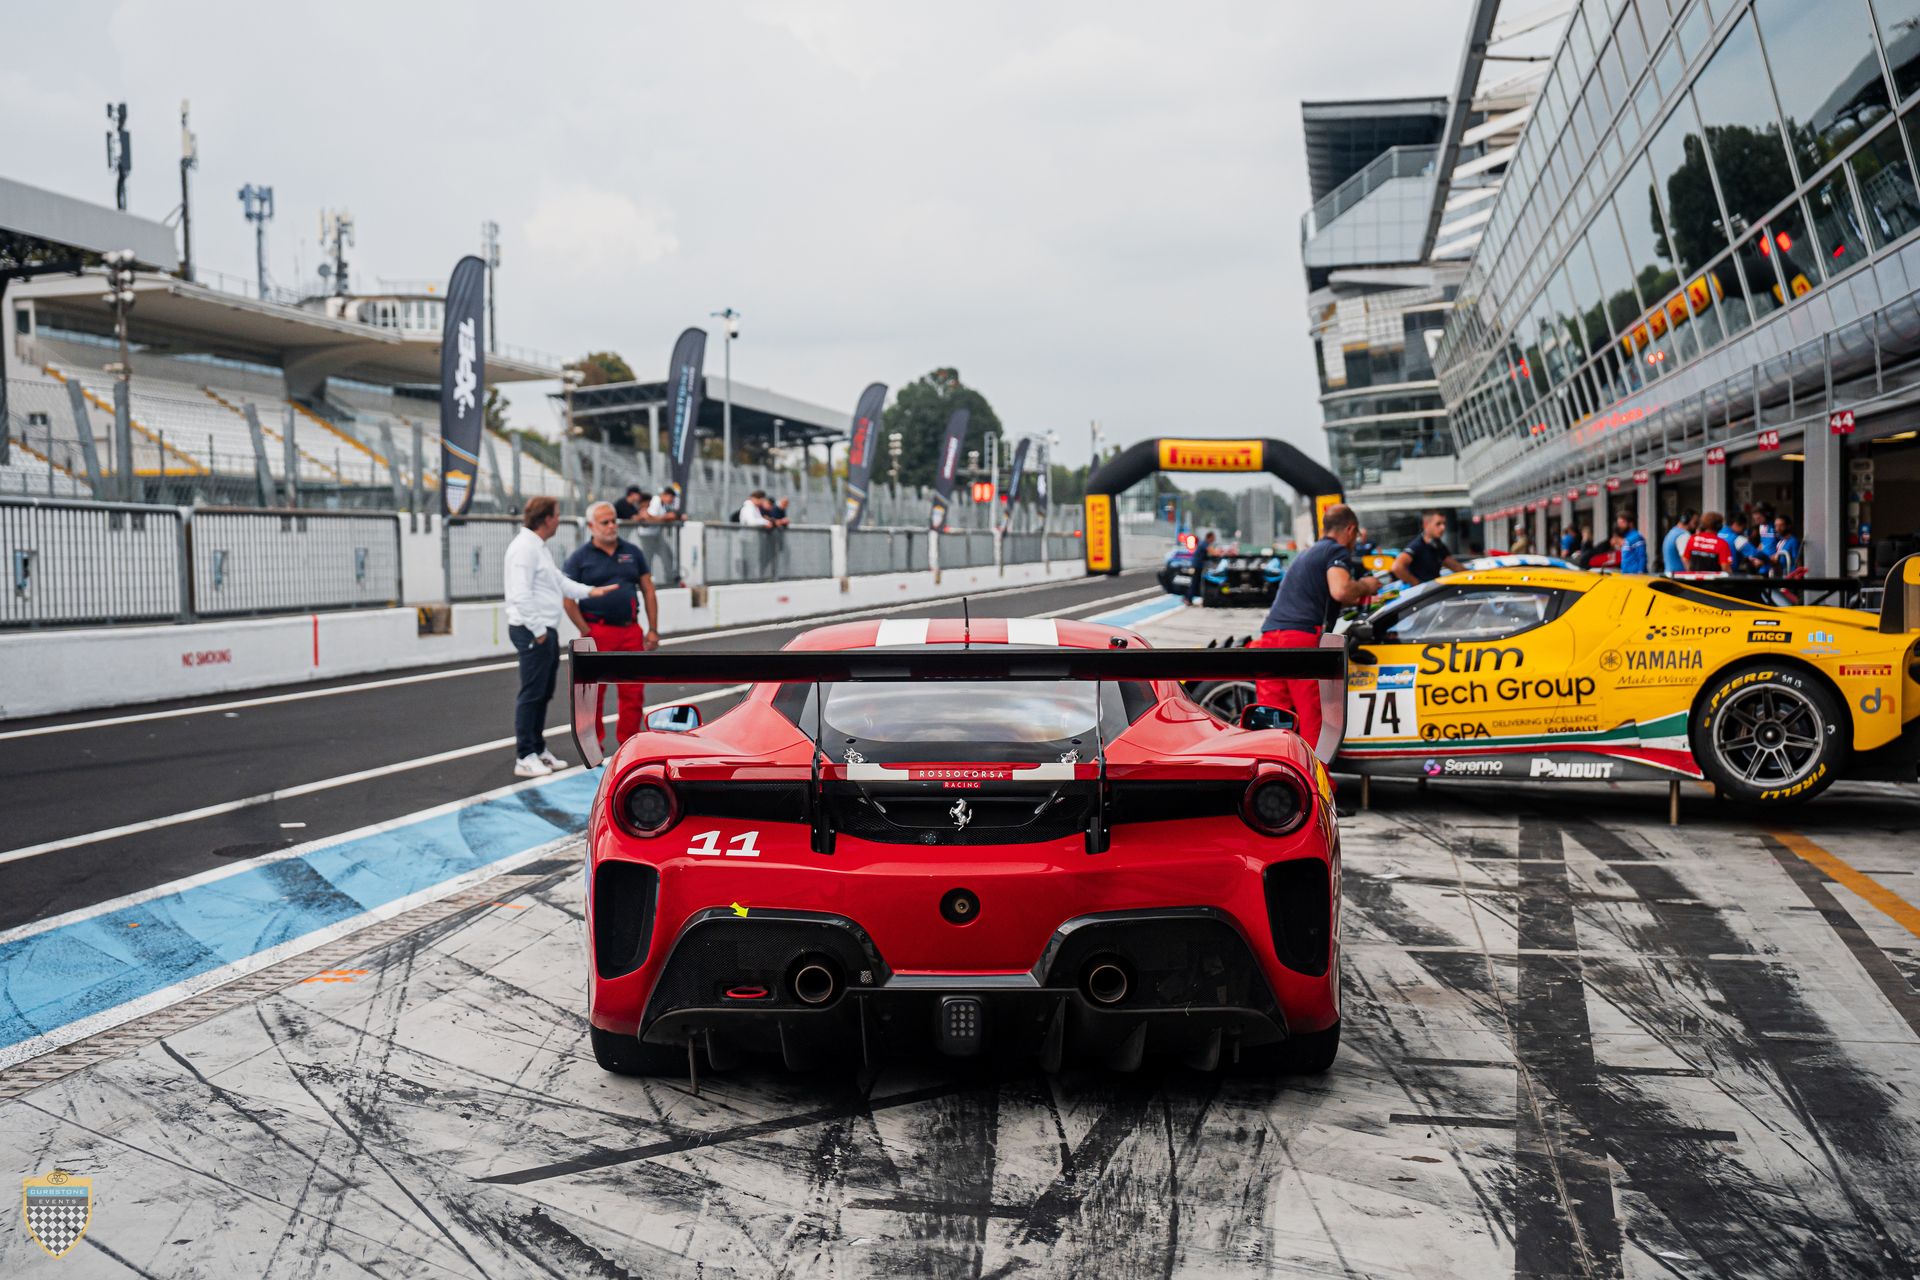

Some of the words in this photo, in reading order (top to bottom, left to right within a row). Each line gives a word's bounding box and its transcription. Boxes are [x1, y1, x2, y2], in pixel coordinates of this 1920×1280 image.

[1831, 413, 1854, 427] 44
[1758, 432, 1779, 445] 45
[1170, 447, 1251, 466] PIRELLI
[1671, 625, 1731, 638] Sintpro
[1752, 632, 1786, 641] mca
[1419, 643, 1524, 675] Stim
[1625, 649, 1703, 670] YAMAHA
[1839, 664, 1892, 676] PIRELLI
[1416, 681, 1488, 706] Tech
[1496, 675, 1596, 704] Group
[1359, 692, 1400, 736] 74
[1492, 718, 1541, 728] DELIVERING
[1544, 714, 1598, 725] EXCELLENCE
[1443, 723, 1492, 740] GPA
[1547, 725, 1599, 734] GLOBALLY
[1445, 759, 1503, 772] Serenno
[1529, 758, 1614, 778] PANDUIT
[919, 769, 1004, 779] ROSSOCORSA
[1760, 762, 1827, 799] PIRELLI
[687, 830, 761, 857] 11
